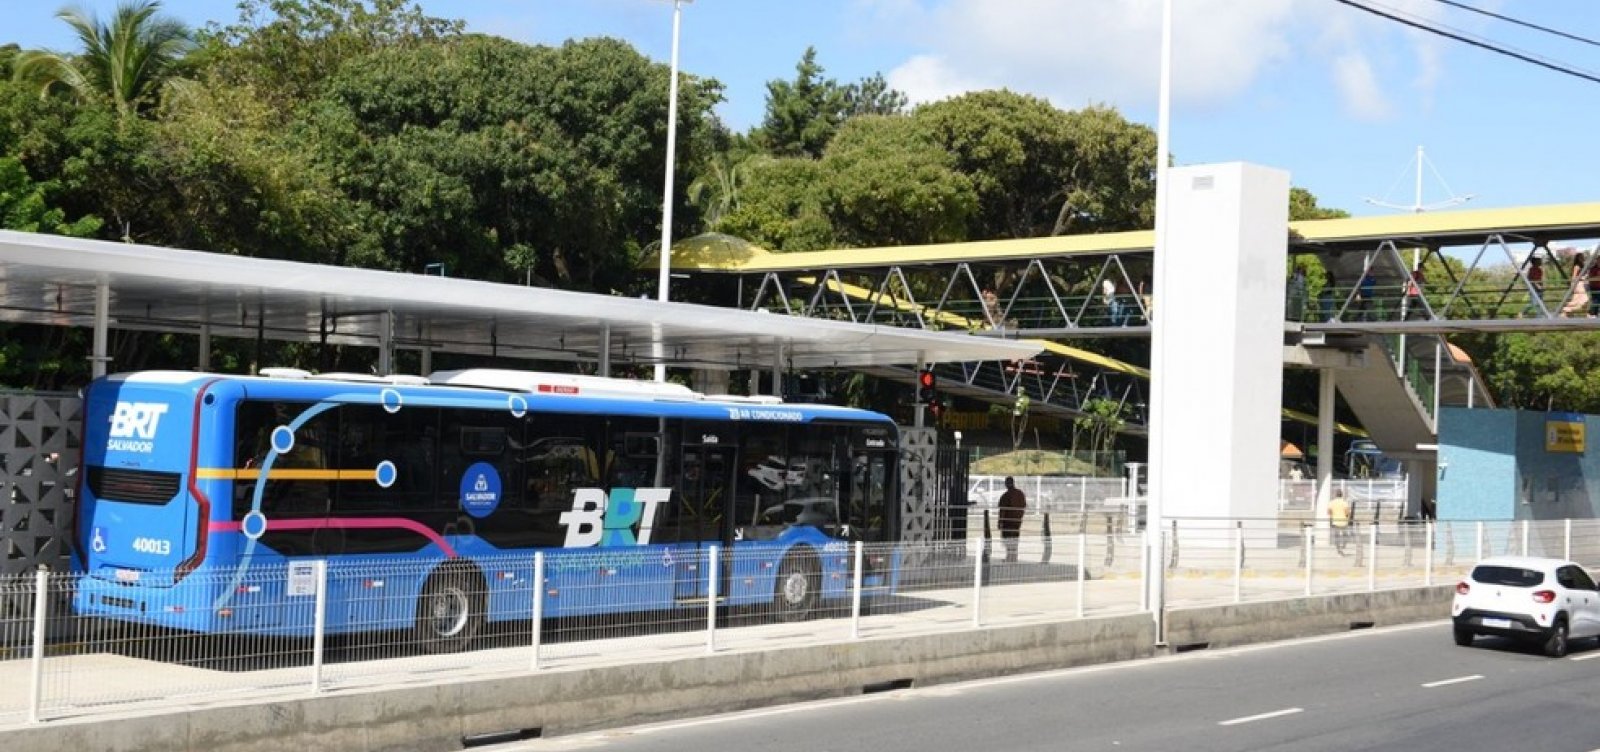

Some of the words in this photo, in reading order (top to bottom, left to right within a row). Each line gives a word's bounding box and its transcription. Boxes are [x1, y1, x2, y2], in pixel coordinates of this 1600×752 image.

[109, 401, 169, 438] BRT
[107, 439, 154, 453] SALVADOR
[559, 487, 673, 548] BRT
[132, 537, 169, 555] 40013
